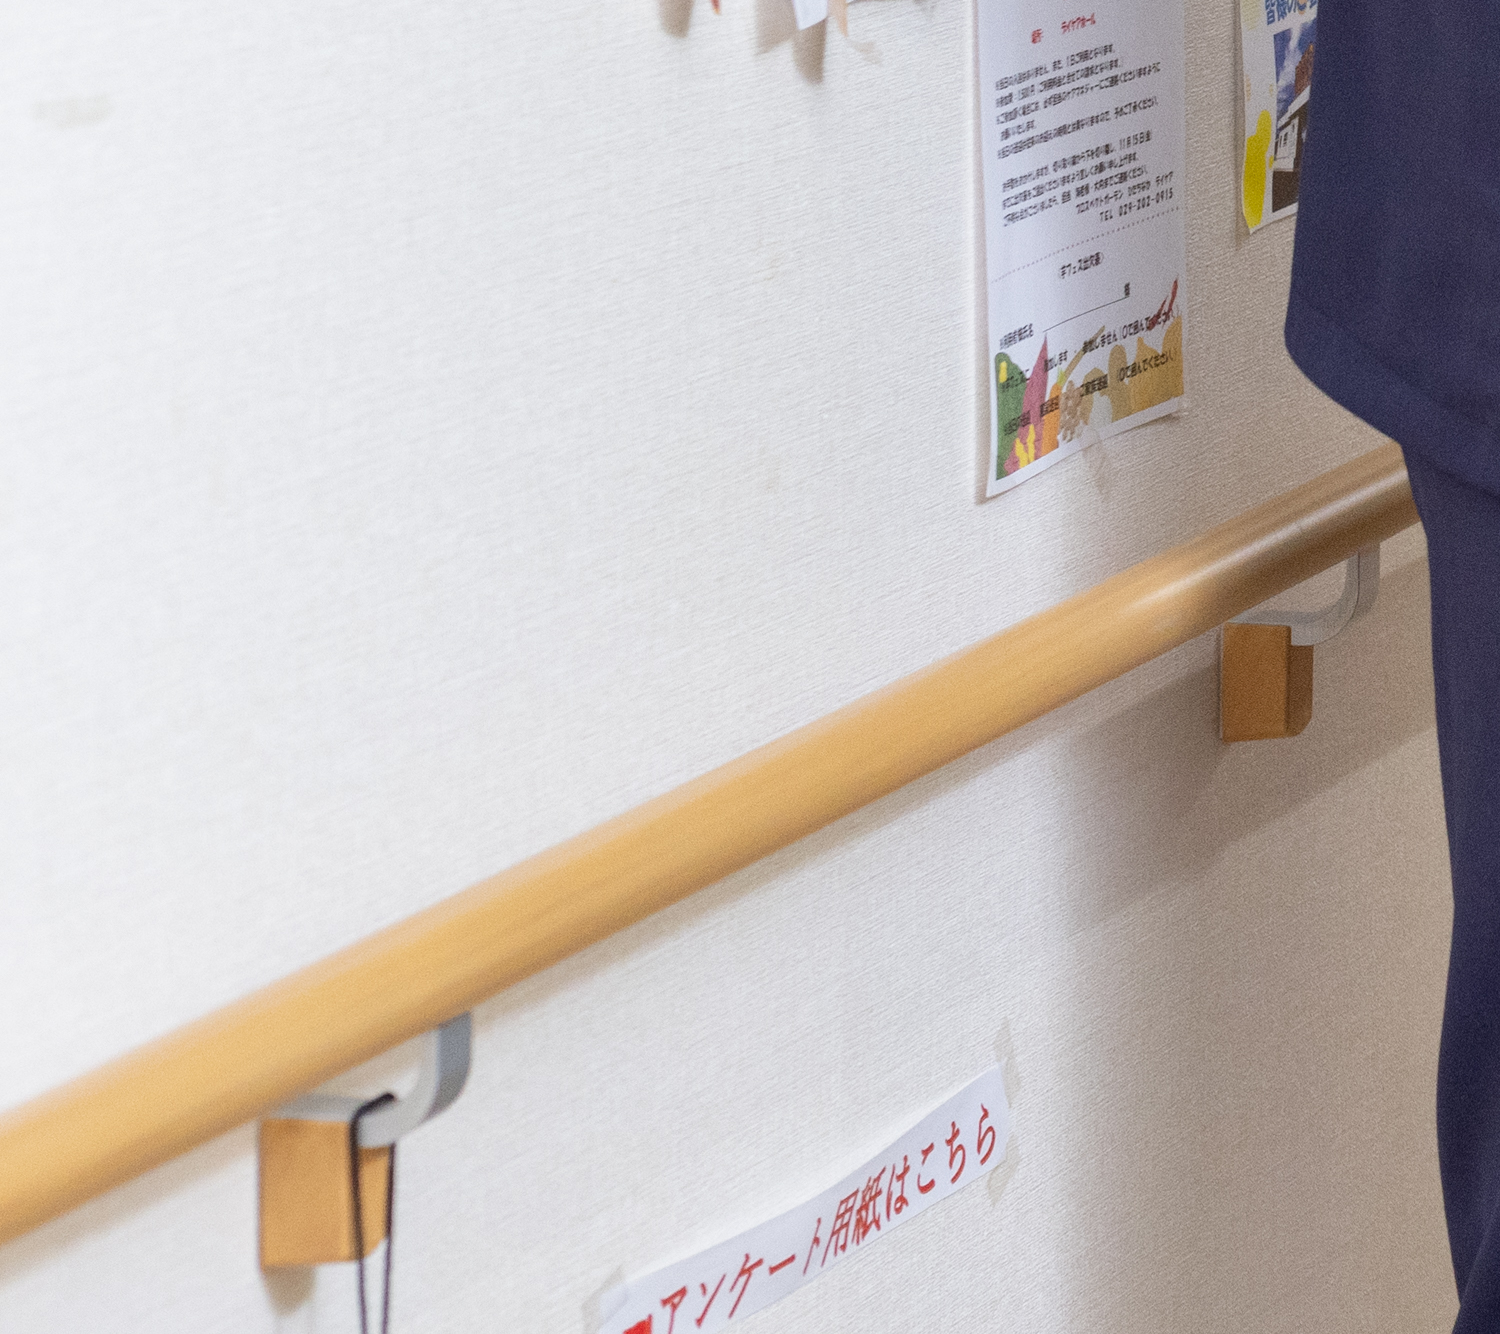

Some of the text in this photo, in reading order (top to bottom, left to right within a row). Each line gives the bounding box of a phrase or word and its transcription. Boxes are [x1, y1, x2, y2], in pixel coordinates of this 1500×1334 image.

[1100, 209, 1113, 222] TEL
[660, 1103, 997, 1334] アンケート用紙はこちら
